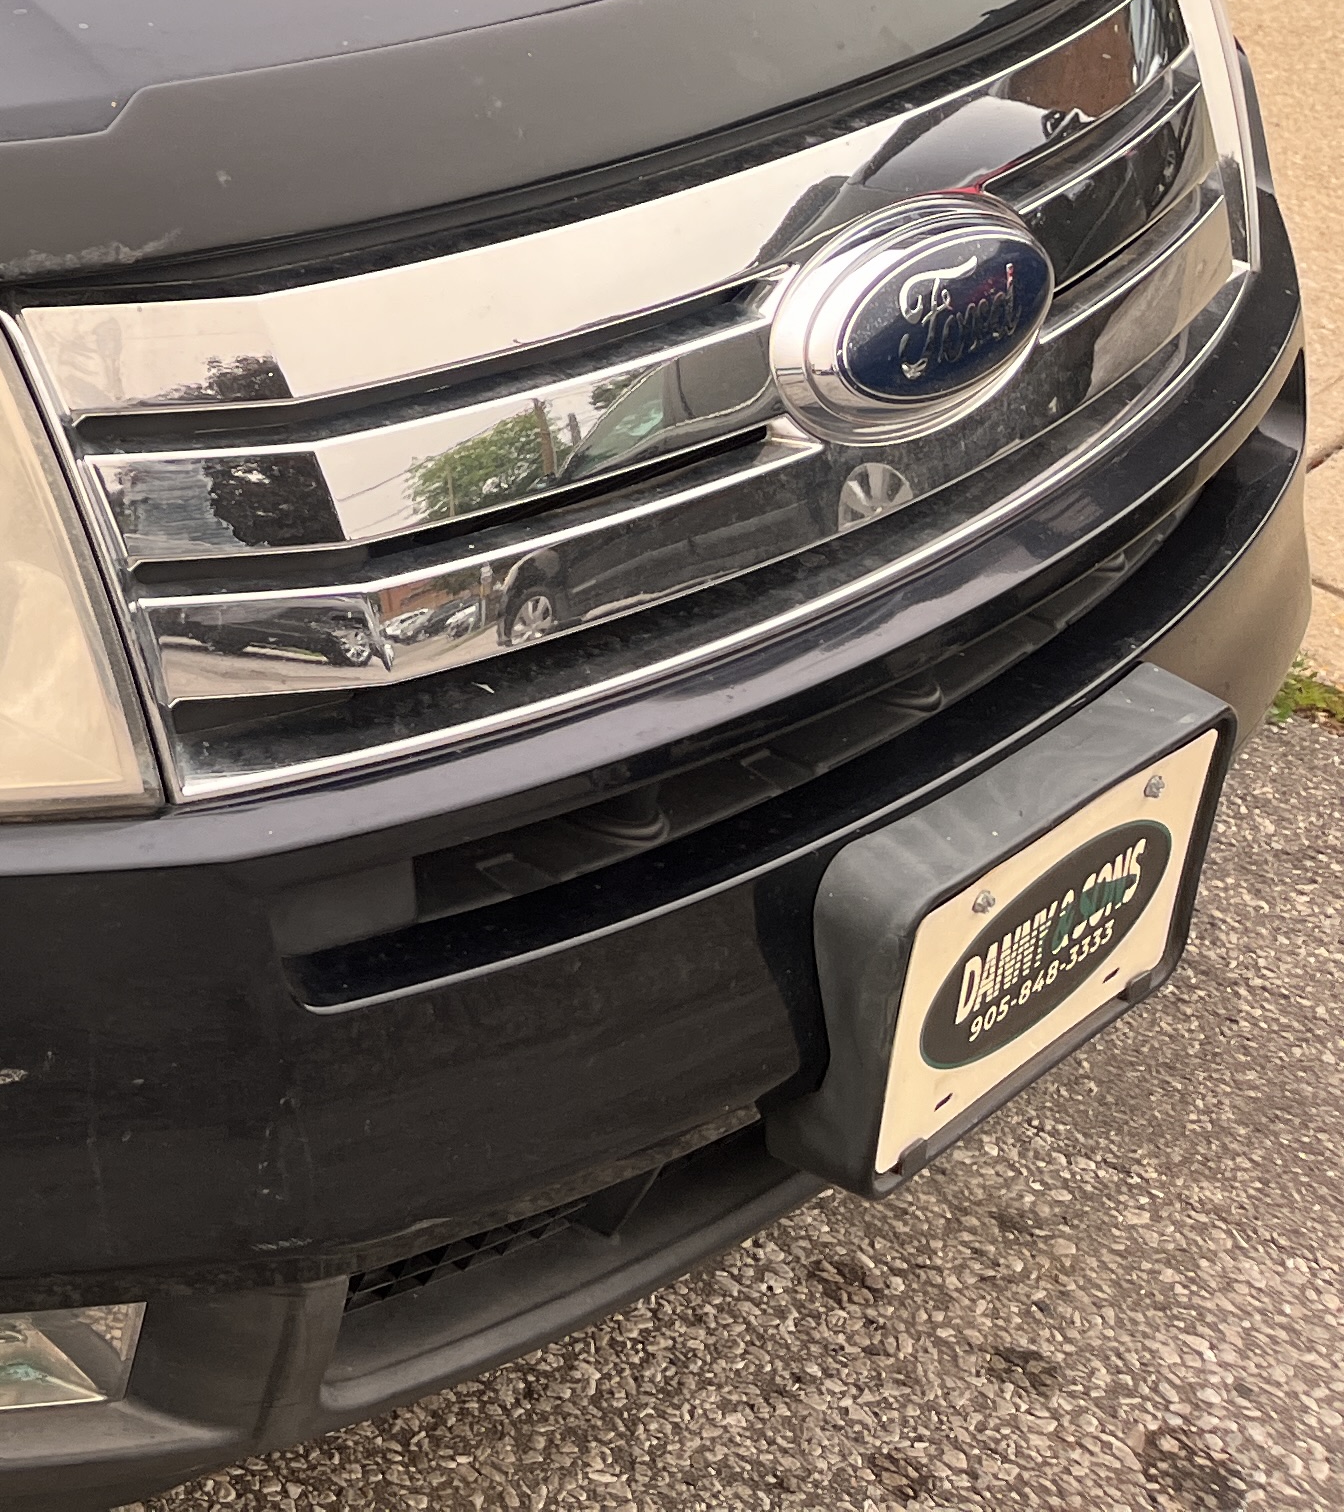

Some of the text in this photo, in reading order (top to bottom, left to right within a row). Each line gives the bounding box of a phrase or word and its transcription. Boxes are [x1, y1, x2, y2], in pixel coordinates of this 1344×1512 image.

[897, 254, 1022, 381] Ford
[954, 900, 1059, 1025] DANNY
[1072, 837, 1147, 940] SONS
[968, 918, 1115, 1043] 905-848-3333
